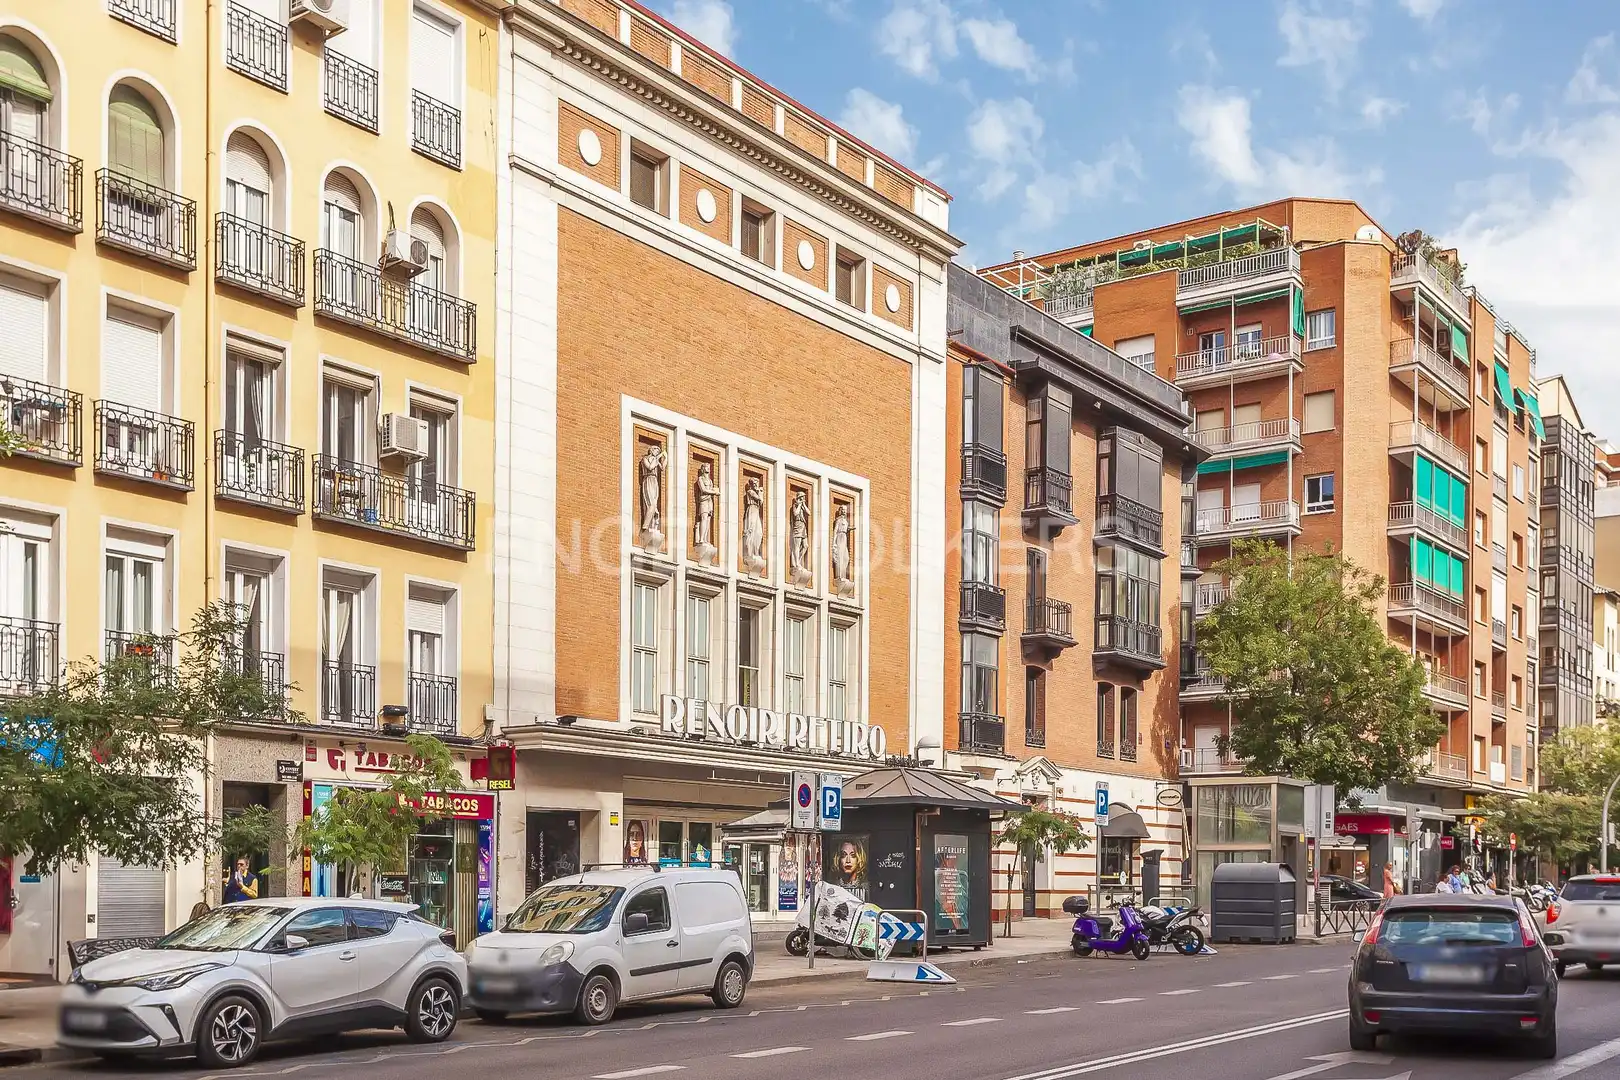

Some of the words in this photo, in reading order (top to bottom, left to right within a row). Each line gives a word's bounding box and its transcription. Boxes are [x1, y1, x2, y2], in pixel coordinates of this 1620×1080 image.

[661, 694, 778, 745] RENOIR
[786, 713, 887, 760] RETIRO
[489, 780, 512, 789] RESEL
[421, 795, 479, 812] TABACOS
[825, 789, 837, 816] P
[1098, 792, 1106, 813] P
